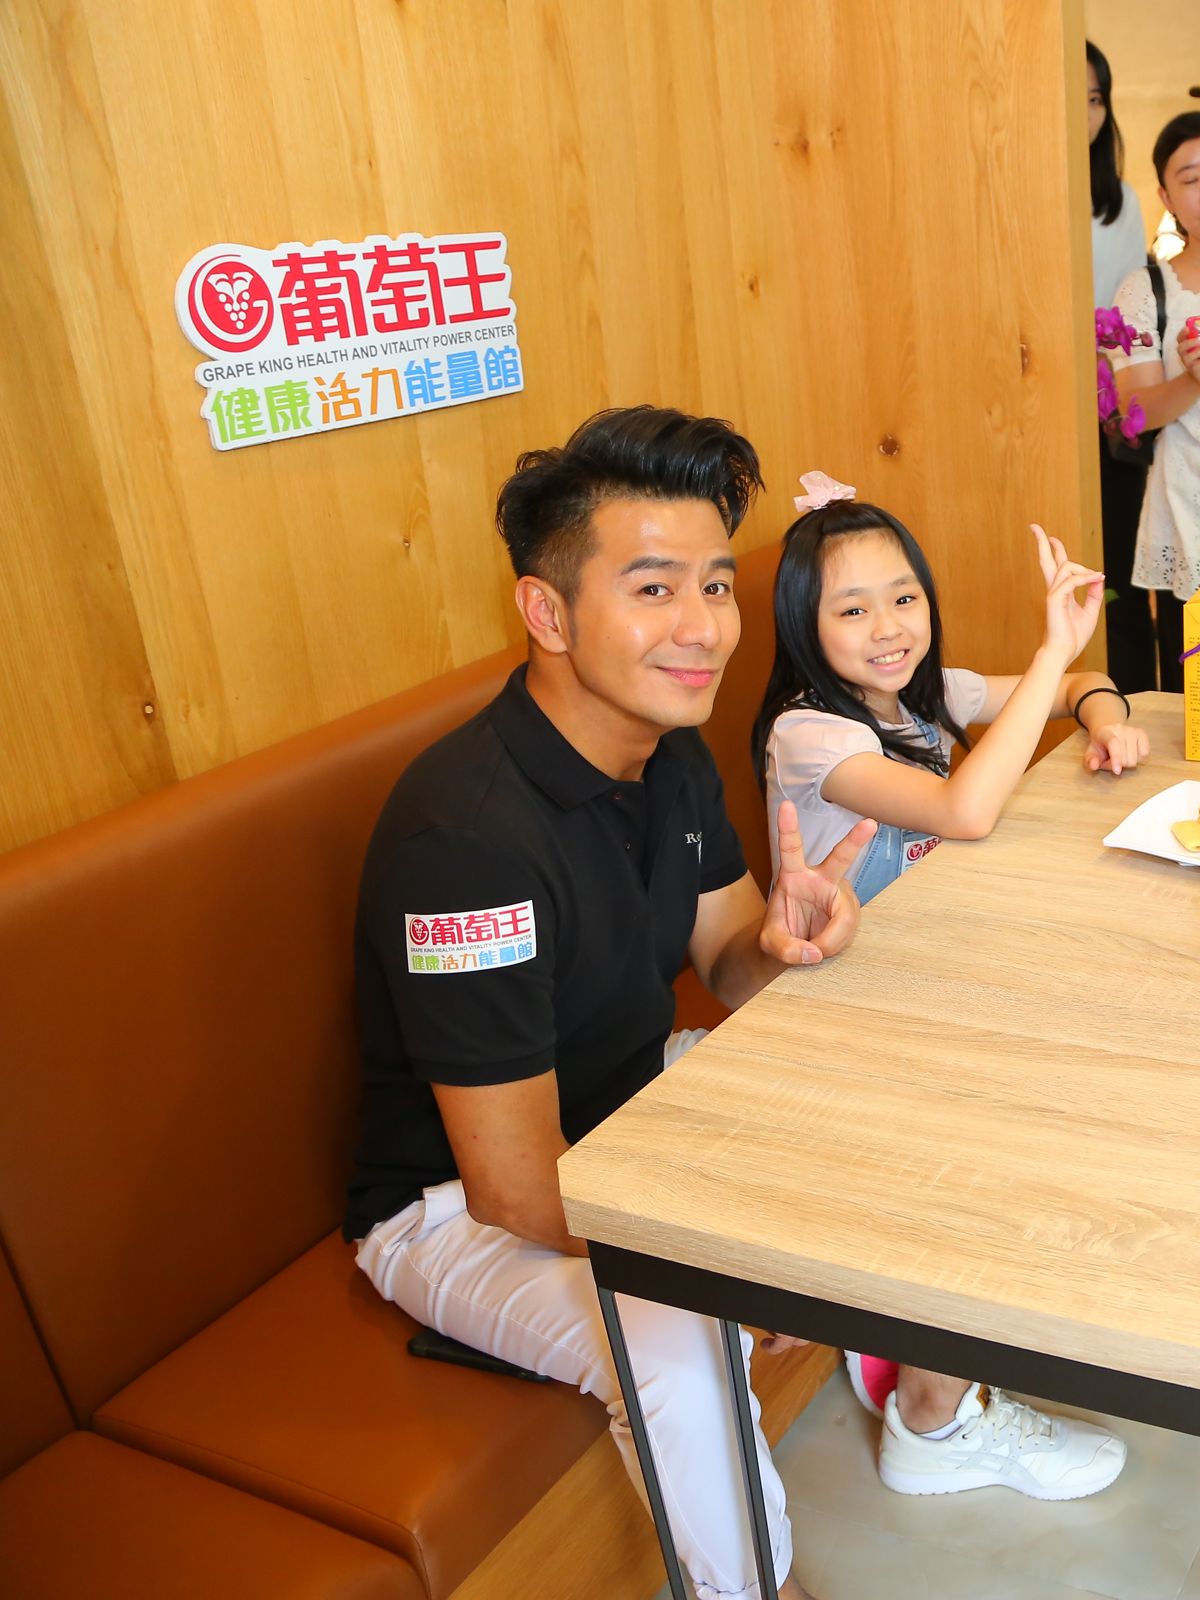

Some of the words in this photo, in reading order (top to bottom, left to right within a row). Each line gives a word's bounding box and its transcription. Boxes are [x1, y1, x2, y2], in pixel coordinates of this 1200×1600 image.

[272, 240, 511, 346] 葡萄王
[203, 362, 255, 383] GRAPE
[258, 356, 294, 374] KING
[297, 349, 349, 368] HEALTH
[351, 344, 378, 360] AND
[379, 336, 430, 356] VITALITY
[432, 331, 473, 347] POWER
[475, 324, 516, 340] CENTER
[210, 345, 522, 444] 健康活力能量館
[429, 906, 531, 946] 葡萄王
[411, 941, 533, 971] 健康活力能館
